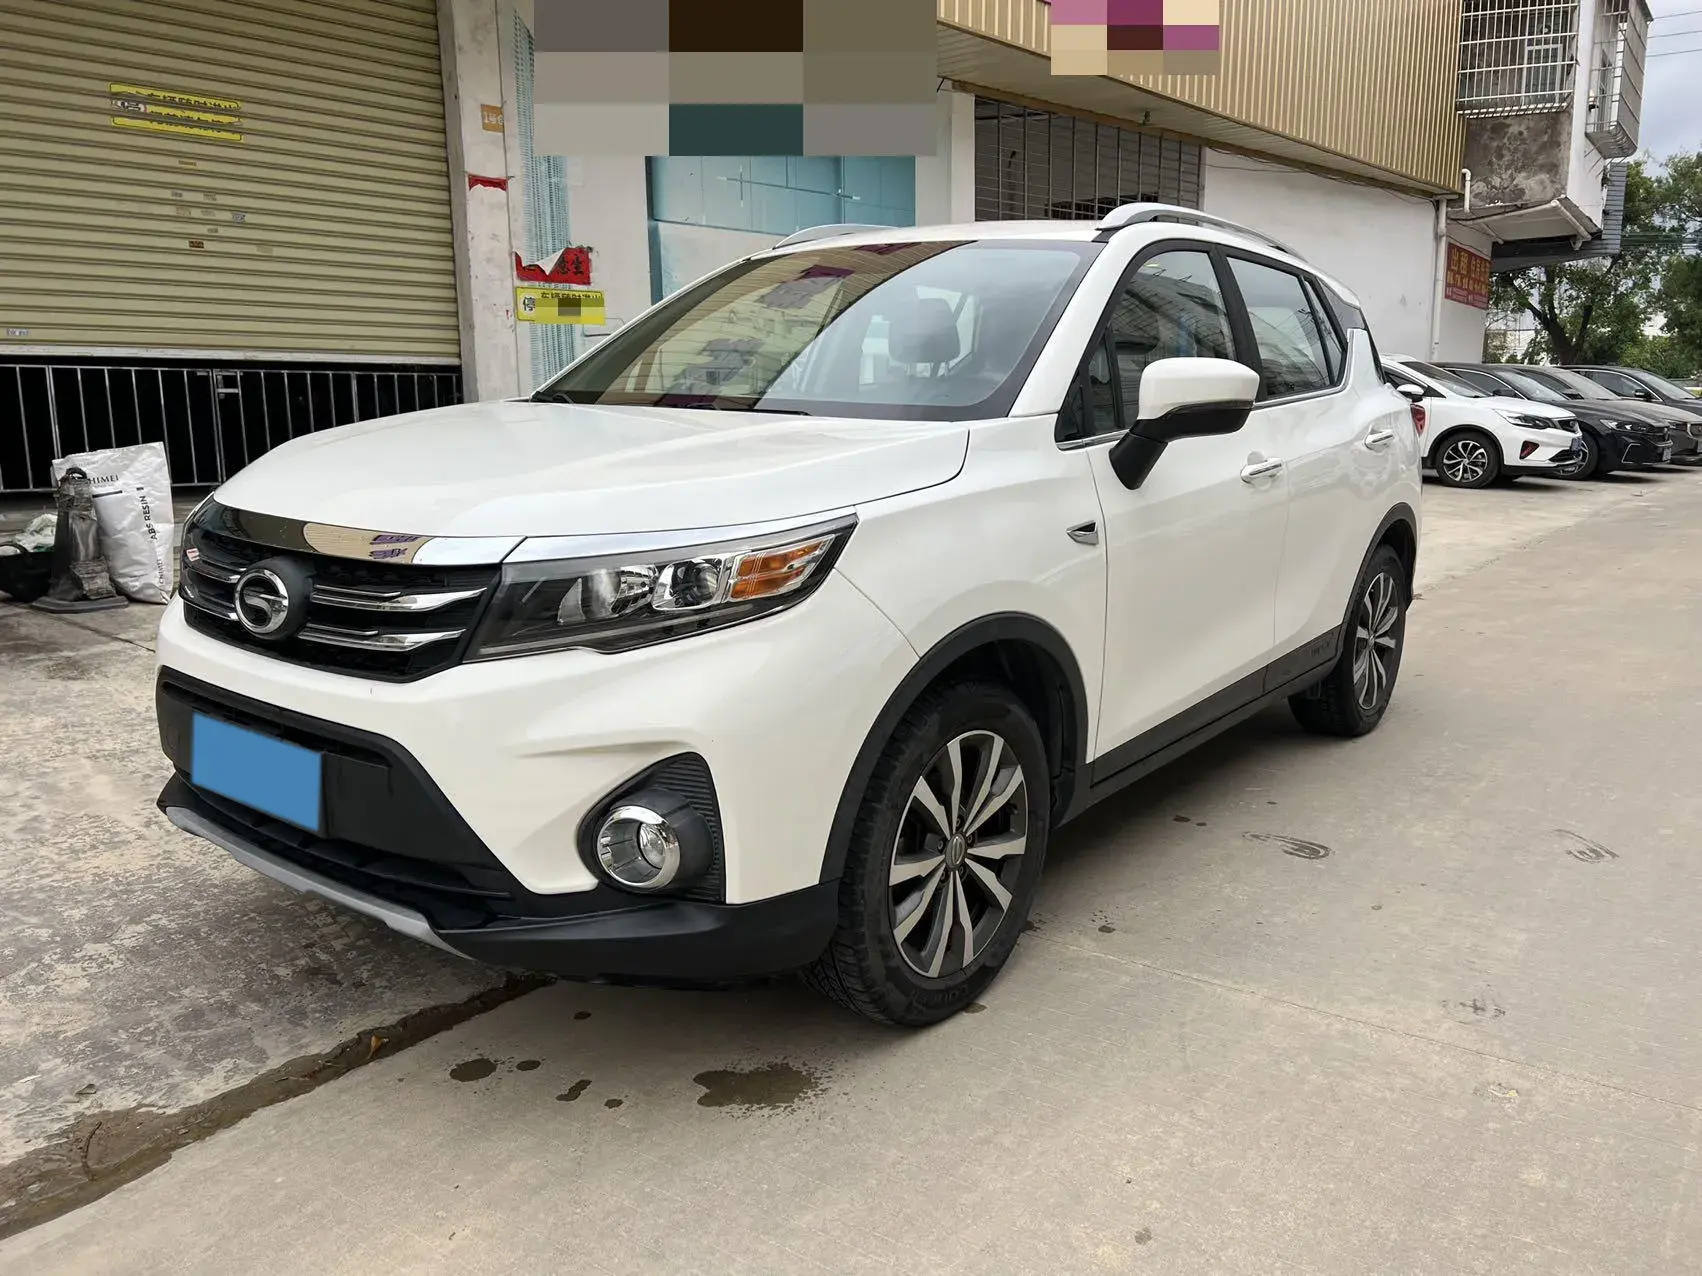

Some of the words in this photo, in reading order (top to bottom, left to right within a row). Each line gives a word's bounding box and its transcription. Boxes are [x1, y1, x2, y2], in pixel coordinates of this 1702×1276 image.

[88, 474, 119, 485] HIMEI
[139, 495, 152, 522] RESIN
[146, 523, 158, 541] ABS
